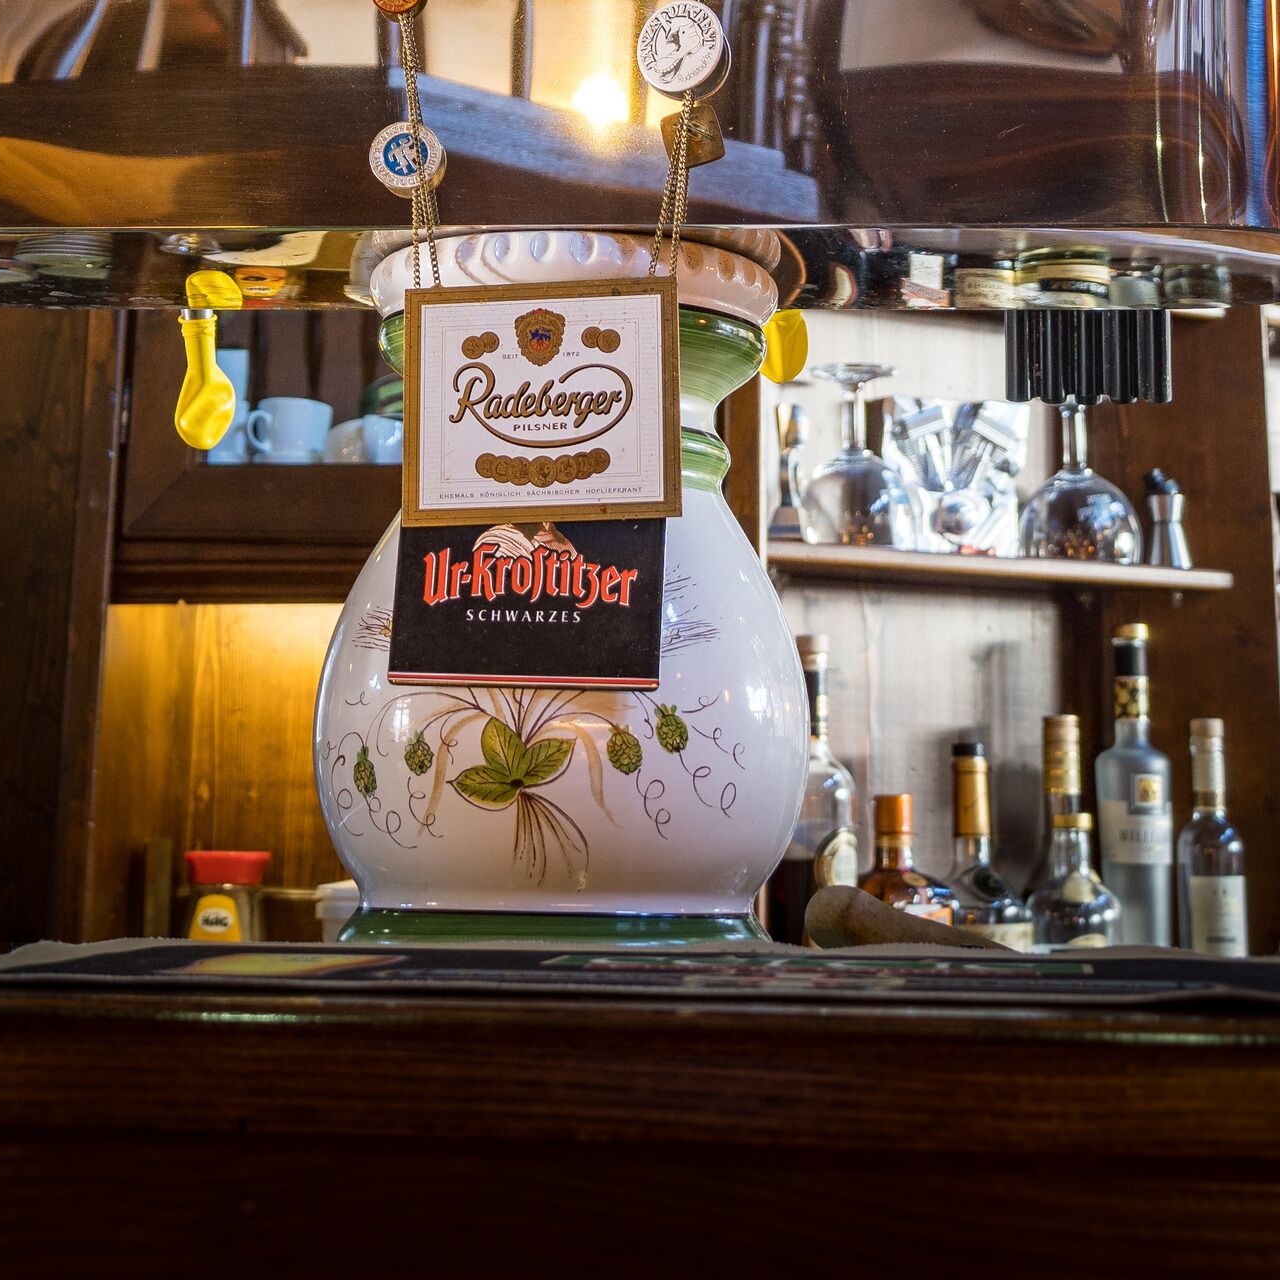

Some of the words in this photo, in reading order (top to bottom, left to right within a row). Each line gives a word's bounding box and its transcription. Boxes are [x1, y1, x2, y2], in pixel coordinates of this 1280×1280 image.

[502, 353, 519, 361] SEIT
[449, 362, 626, 430] Radeberger
[513, 422, 568, 432] PILSNER
[439, 492, 474, 500] EHEMALS
[480, 490, 521, 498] KÖNIGLICH
[526, 488, 580, 497] SÄCHSISCHER
[585, 486, 643, 495] HOFLIEFERANT
[465, 608, 582, 623] SCHWARZES
